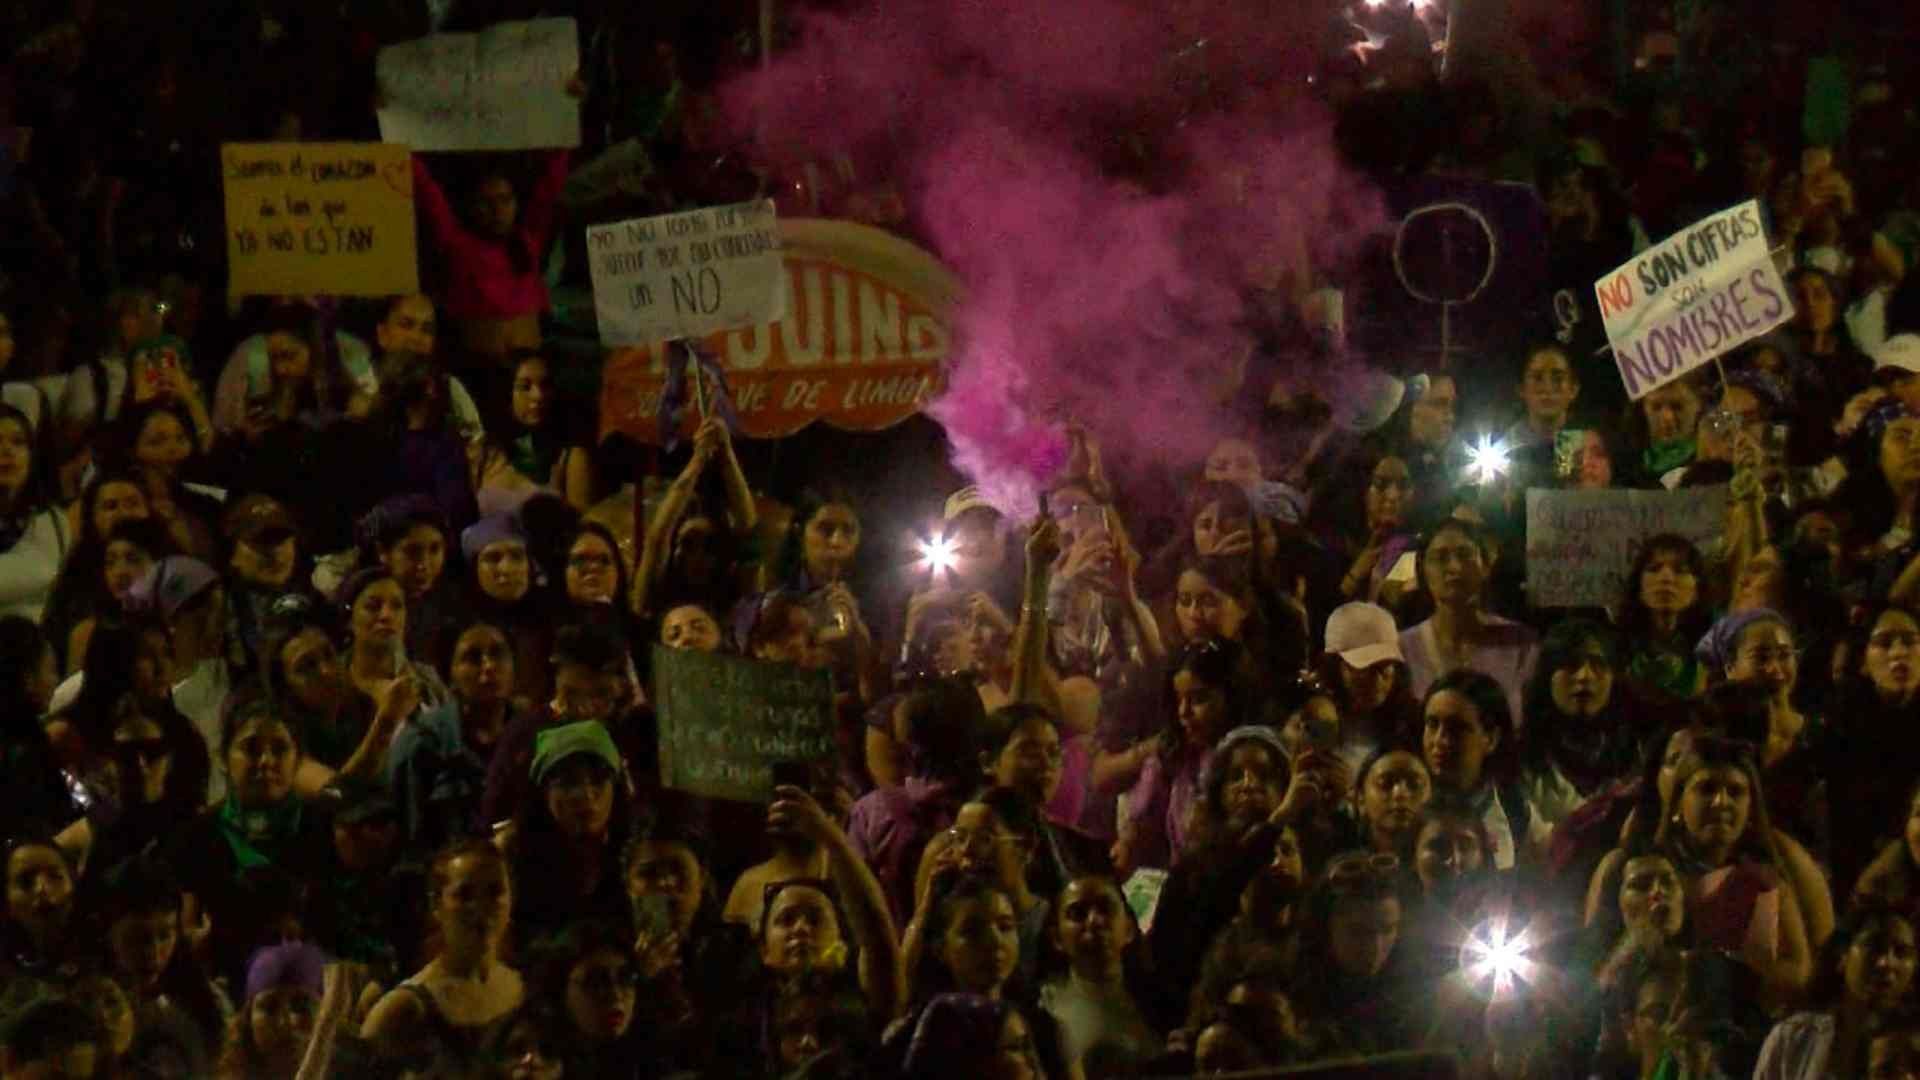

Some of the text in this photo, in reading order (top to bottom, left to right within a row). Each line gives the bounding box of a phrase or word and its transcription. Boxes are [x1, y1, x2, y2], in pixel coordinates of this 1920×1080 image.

[234, 228, 258, 255] YA
[268, 228, 293, 252] NO
[628, 222, 655, 242] NO
[1599, 208, 1757, 318] NO SON CIFRAS
[671, 267, 721, 316] NO
[1617, 269, 1783, 393] NOMBRES
[783, 379, 828, 411] DE
